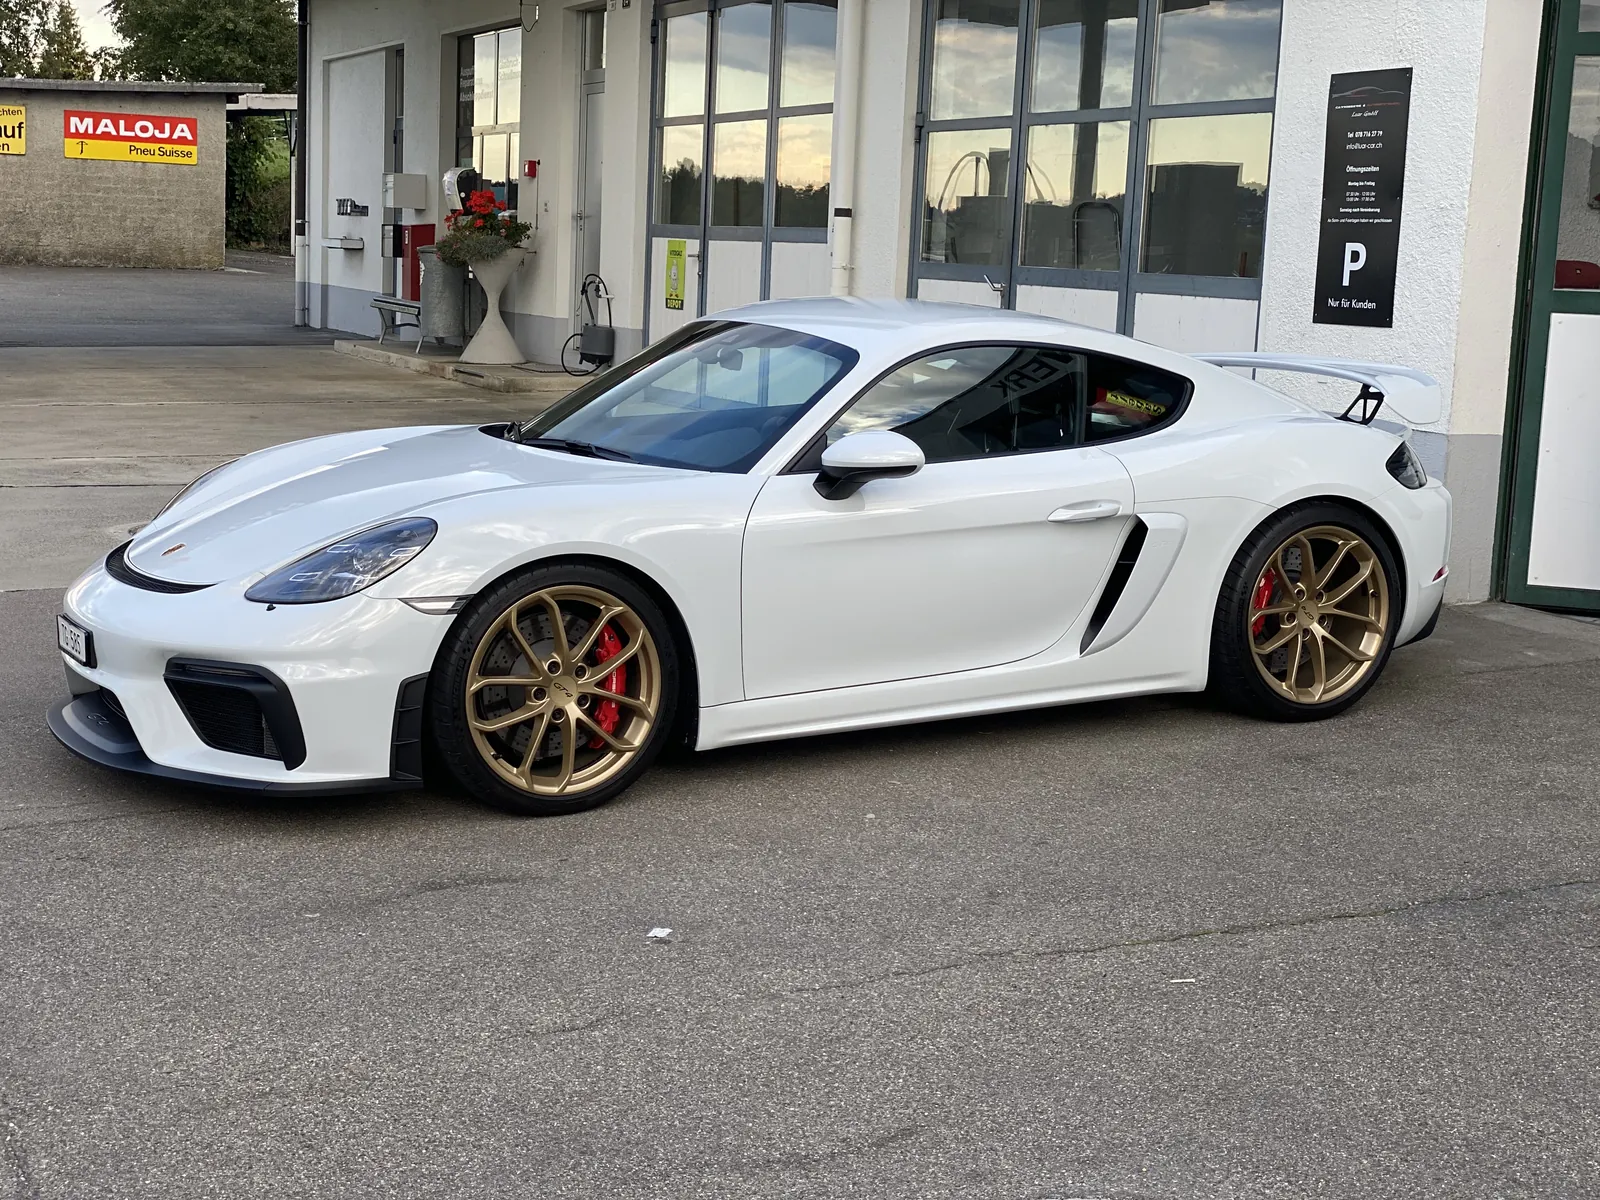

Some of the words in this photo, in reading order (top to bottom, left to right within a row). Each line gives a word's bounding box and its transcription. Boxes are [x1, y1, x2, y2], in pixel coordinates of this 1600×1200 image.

[0, 121, 24, 139] uf
[69, 116, 193, 140] MALOJA
[0, 143, 10, 151] n
[129, 144, 156, 156] Pneu
[157, 146, 193, 158] Suisse
[1345, 164, 1380, 174] Öffnungszeiten
[1342, 242, 1367, 287] P
[667, 298, 682, 309] DEPOT
[1327, 297, 1340, 308] Nur
[1340, 298, 1351, 309] für
[1351, 299, 1377, 310] Kunden
[553, 682, 574, 698] GT4
